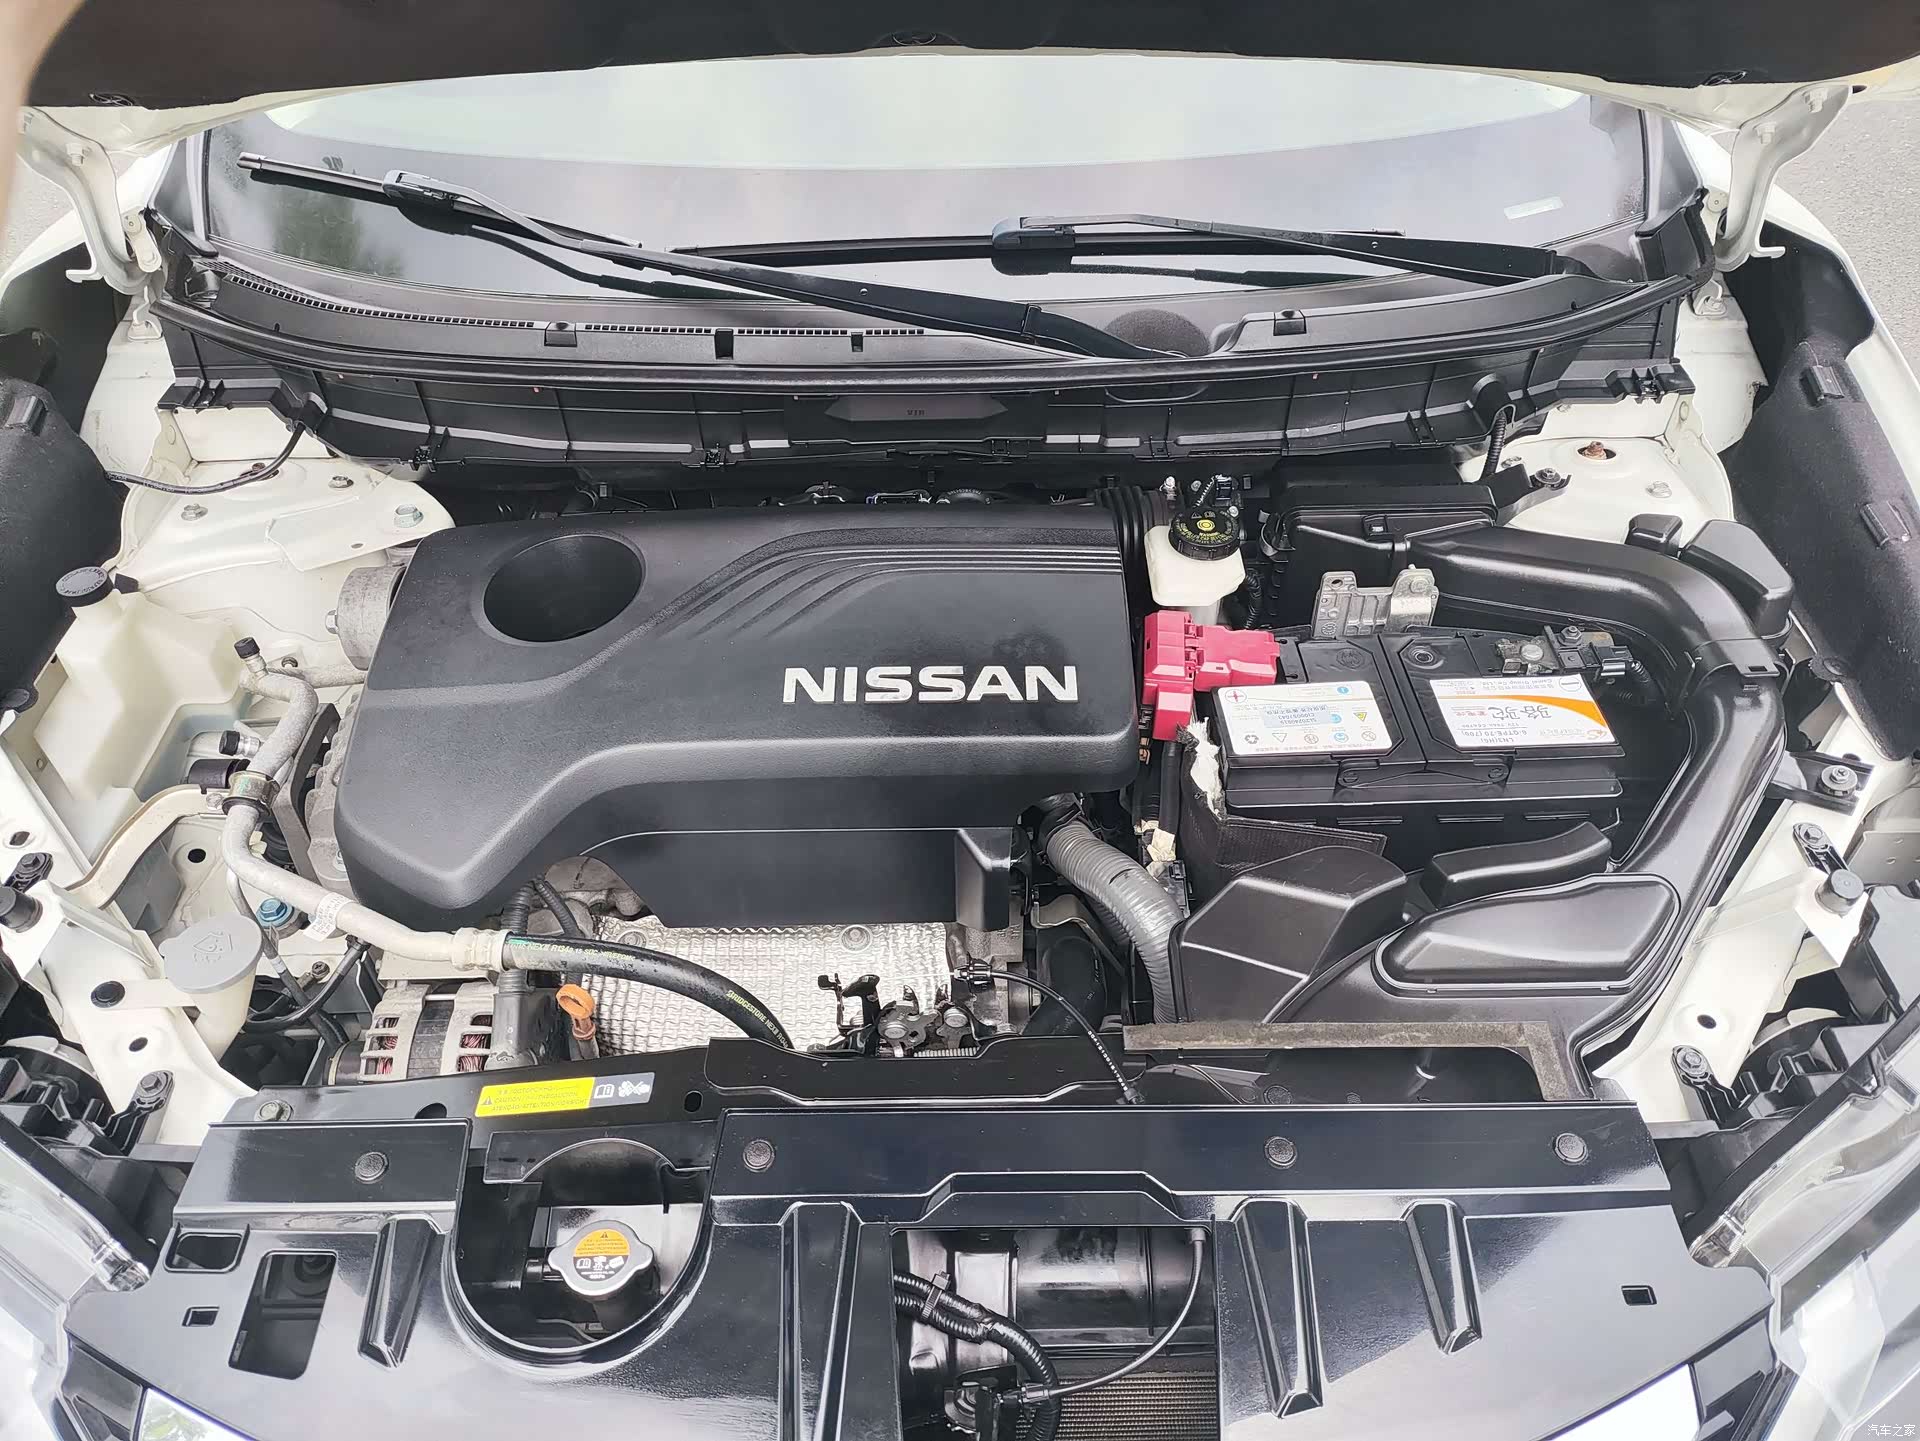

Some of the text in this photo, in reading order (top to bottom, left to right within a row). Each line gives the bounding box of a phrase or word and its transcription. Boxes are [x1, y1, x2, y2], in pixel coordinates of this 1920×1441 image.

[783, 665, 1079, 702] NISSAN
[1488, 705, 1552, 720] 骆驼
[726, 989, 767, 1023] BRIDGESTONE
